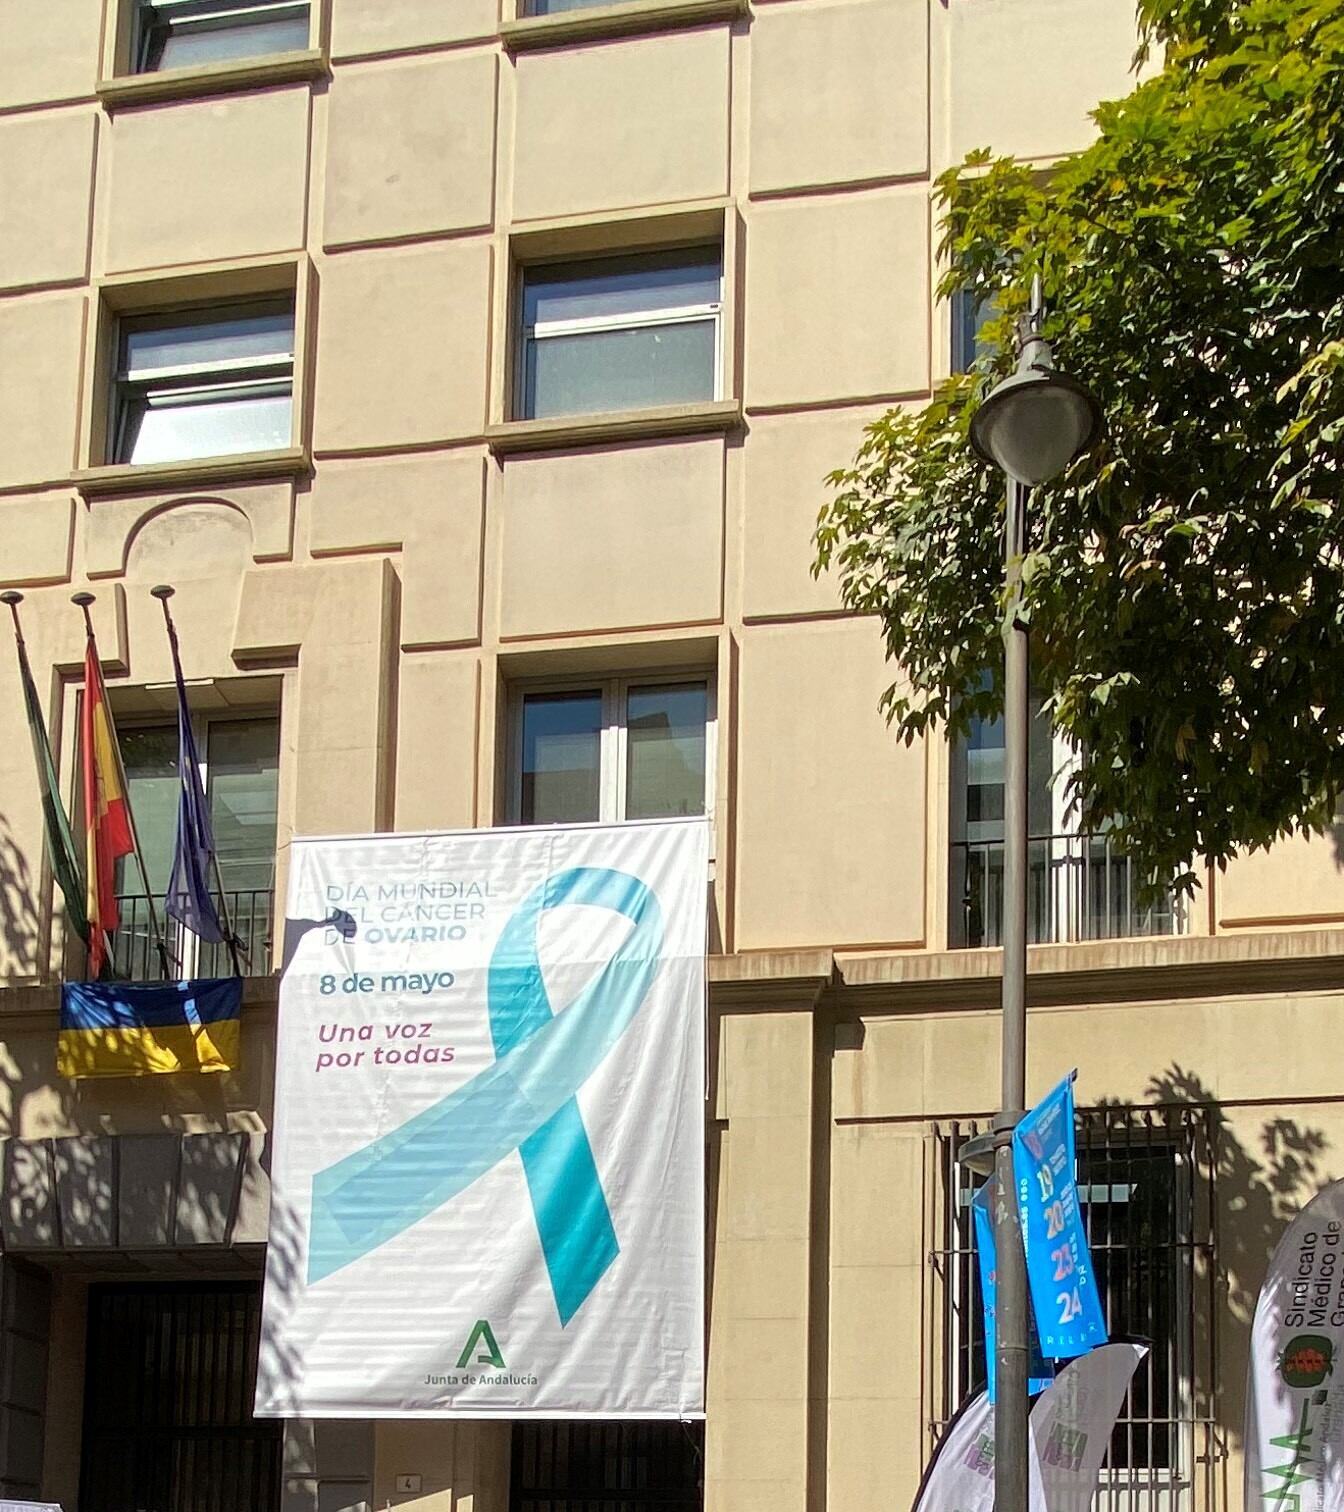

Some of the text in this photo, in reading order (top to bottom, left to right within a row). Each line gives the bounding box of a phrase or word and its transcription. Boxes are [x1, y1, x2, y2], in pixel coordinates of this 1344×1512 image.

[327, 881, 498, 902] DÍA MUNDIAL
[325, 906, 373, 924] DEL
[324, 925, 467, 946] DE OVARIO
[320, 972, 455, 995] 8 de mayo
[319, 1023, 433, 1042] Una voz
[316, 1044, 455, 1072] por todas
[1285, 1231, 1318, 1328] Sindicato
[1308, 1220, 1342, 1328] Médico de
[1056, 1287, 1083, 1324] 24
[424, 1373, 538, 1386] Junta de Andalucía
